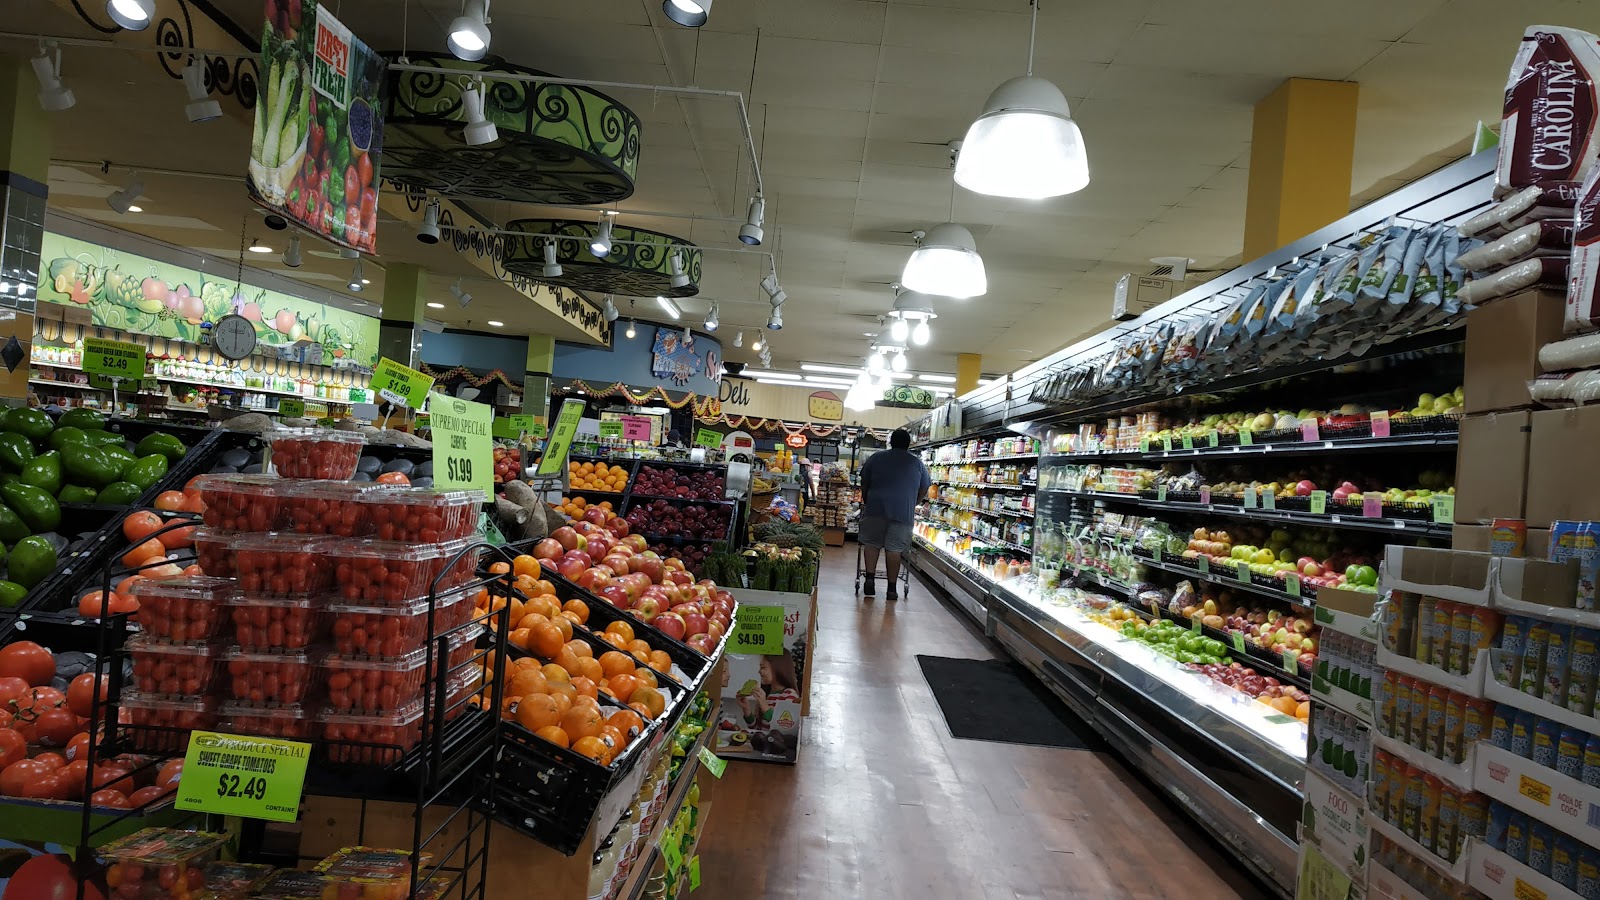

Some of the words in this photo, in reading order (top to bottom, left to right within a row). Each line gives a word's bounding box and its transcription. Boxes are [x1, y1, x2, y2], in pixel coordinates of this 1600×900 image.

[316, 23, 349, 72] JERSEY
[314, 56, 347, 105] FRESH
[1535, 59, 1577, 171] CAROLINA
[103, 356, 128, 369] $2.49
[388, 379, 411, 396] $1.99
[720, 378, 750, 406] Deli
[432, 412, 460, 432] SUPREMO
[460, 418, 487, 436] SPECIAL
[448, 455, 472, 482] $1.99
[738, 633, 765, 646] $4.99
[225, 740, 268, 754] PRODUCE
[268, 744, 307, 759] SPECIAL
[198, 751, 221, 768] SWEET
[220, 752, 243, 771] GRAPE
[242, 755, 277, 774] TOMATOES
[217, 772, 267, 801] $2.49
[265, 804, 295, 814] CONTAINE
[1328, 791, 1348, 815] FOCO
[1561, 803, 1578, 818] COCO
[1574, 799, 1583, 810] DE
